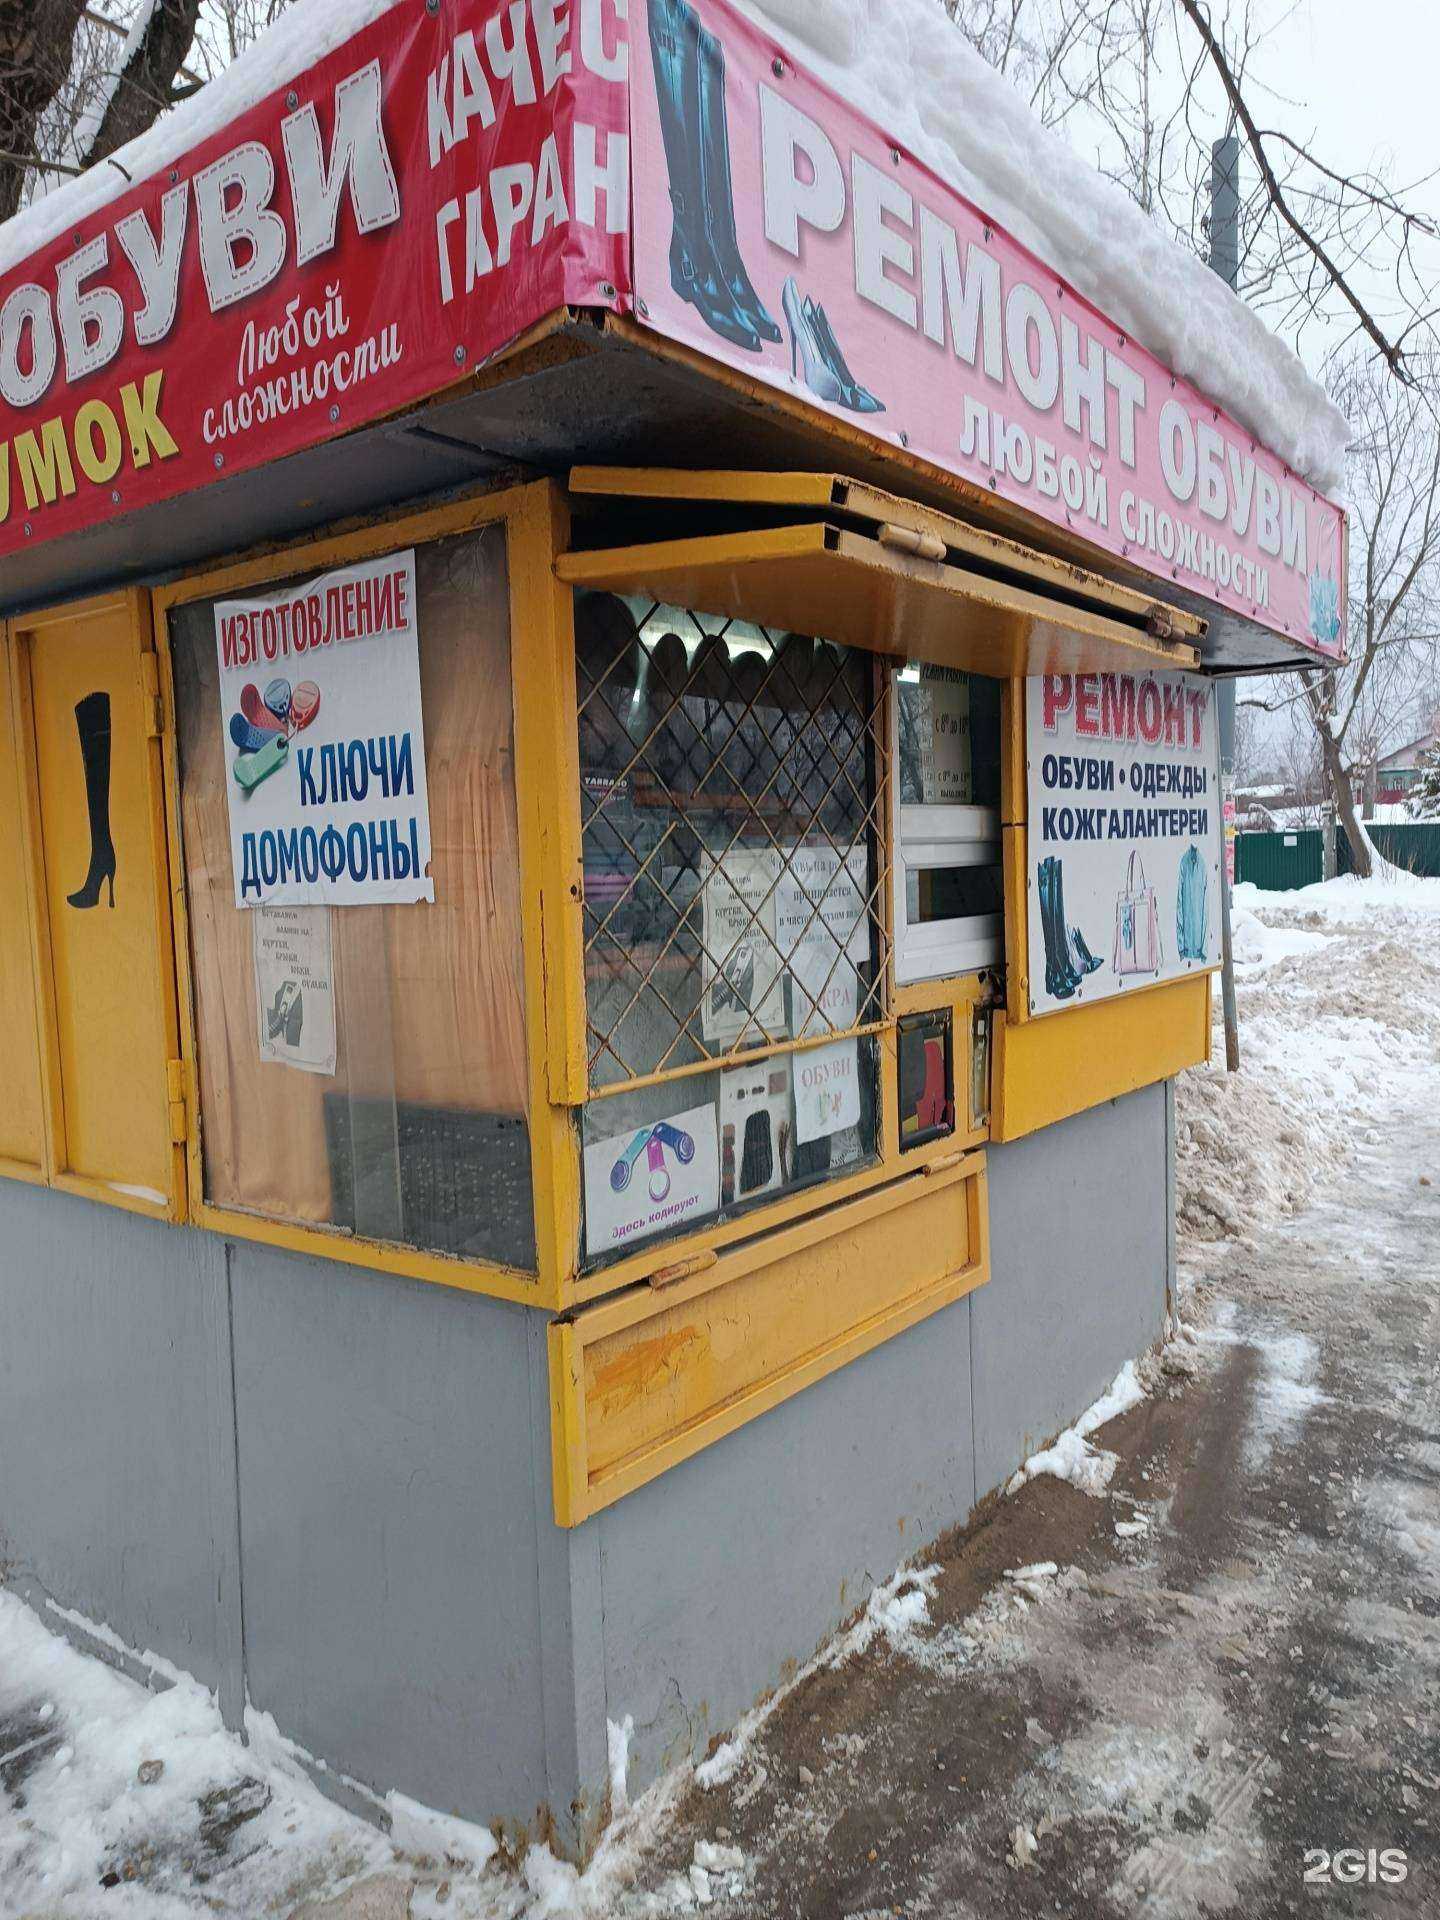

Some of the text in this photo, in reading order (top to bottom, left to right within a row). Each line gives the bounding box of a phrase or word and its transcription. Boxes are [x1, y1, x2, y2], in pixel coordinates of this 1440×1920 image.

[0, 58, 400, 407] ОБУВИ
[238, 279, 349, 386] Любой
[759, 80, 1308, 577] РЕМОНТ ОБУВИ
[203, 323, 403, 444] сложности
[0, 369, 179, 522] МОК
[959, 394, 1270, 608] ЛЮБОЙ СЛОЖНОСТИ
[220, 570, 408, 667] ИЗГОТОВЛЕНИЕ
[1042, 672, 1210, 750] РЕМОНТ
[297, 733, 415, 806] КЛЮЧИ
[1042, 754, 1207, 798] ОБУВИ ОДЕЖДЫ
[241, 818, 420, 898] ДОМОФОНЫ
[1042, 807, 1209, 841] КОЖГАЛАНТЕРЕИ
[801, 1057, 851, 1088] ОБУВИ
[648, 1194, 700, 1223] кодируют
